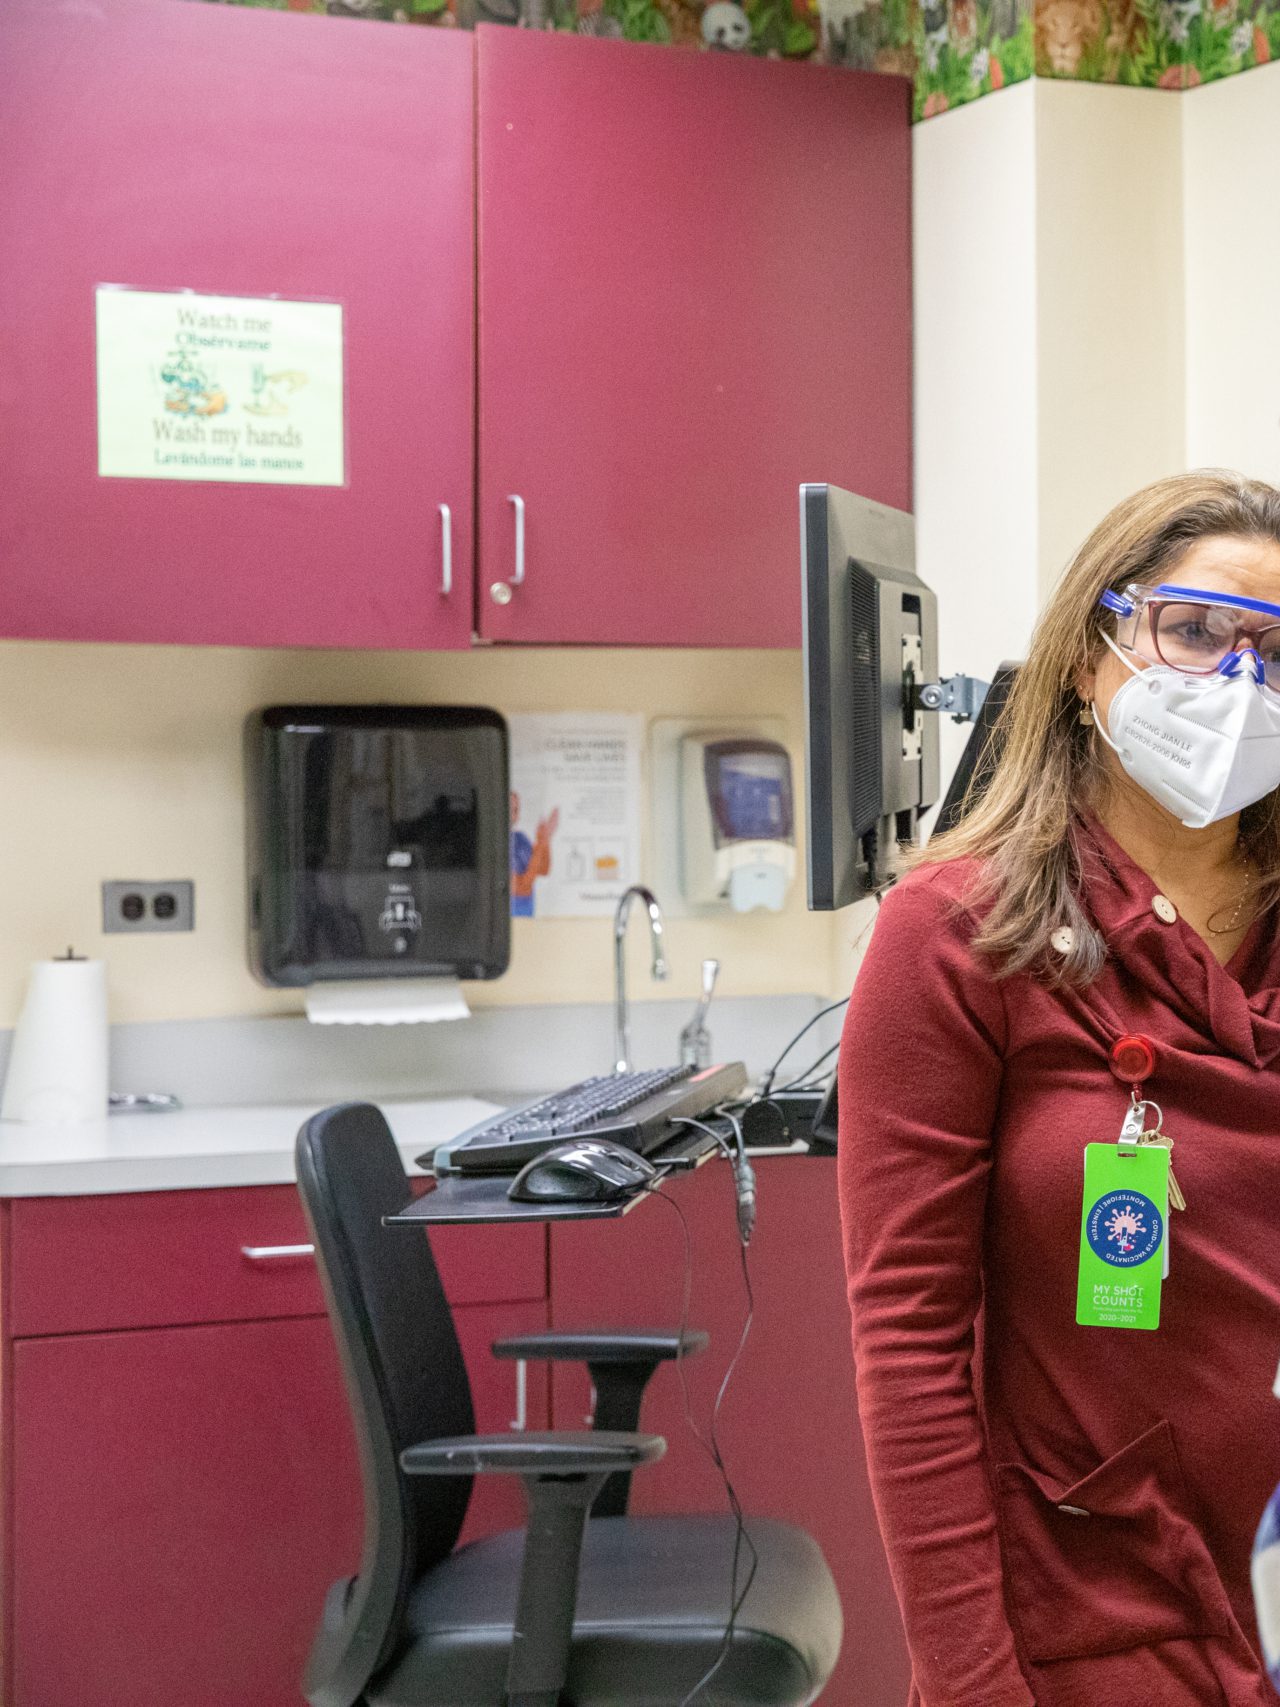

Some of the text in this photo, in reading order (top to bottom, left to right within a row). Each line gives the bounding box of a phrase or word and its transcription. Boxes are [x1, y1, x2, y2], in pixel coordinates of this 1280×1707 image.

[177, 309, 272, 332] Watch me
[153, 418, 303, 451] Wash my hands
[1133, 715, 1160, 736] ZHONG
[1161, 732, 1181, 746] JIAN
[1170, 752, 1192, 769] KN95
[1103, 1194, 1146, 1207] MONTEFIORE
[1091, 1208, 1101, 1240] EINSTEIN
[1106, 1219, 1158, 1263] COVID-19 VACCINATED
[1093, 1284, 1144, 1297] MY SHOT
[1093, 1295, 1143, 1308] COUNTS
